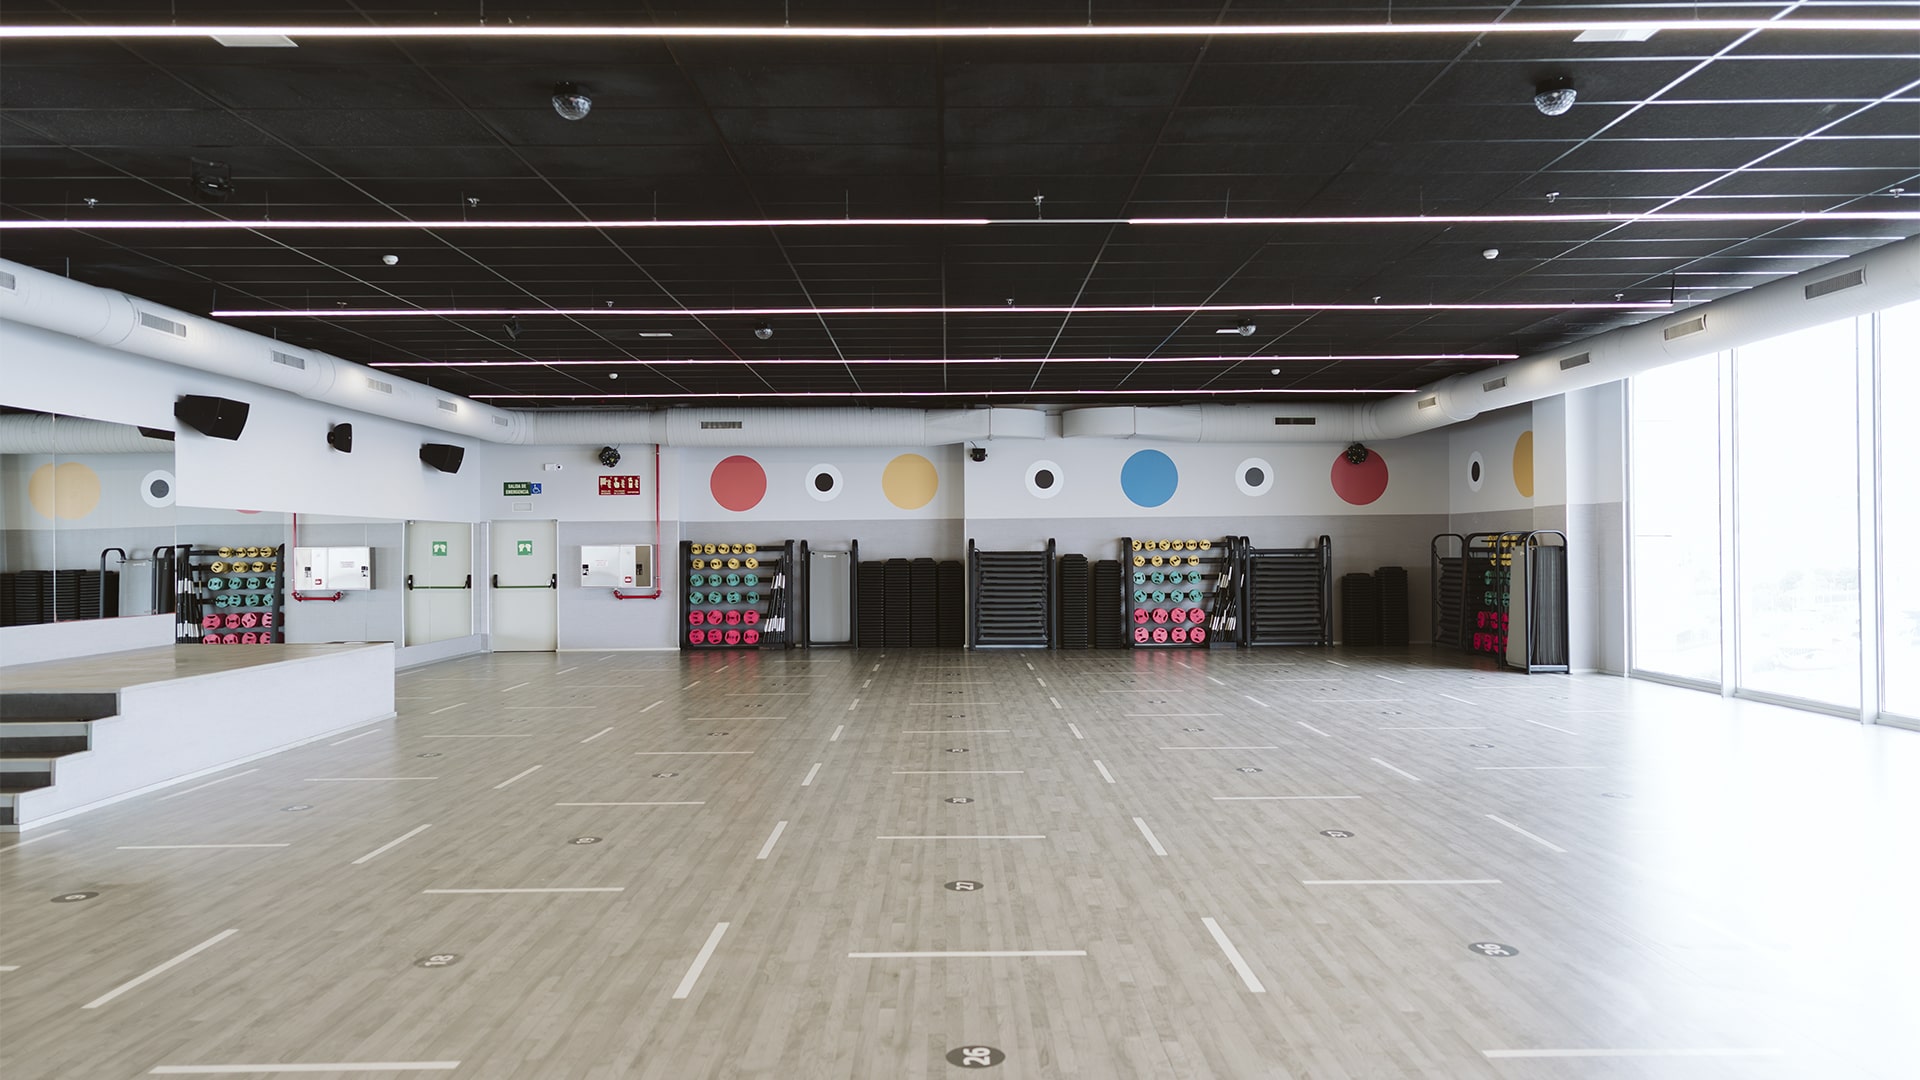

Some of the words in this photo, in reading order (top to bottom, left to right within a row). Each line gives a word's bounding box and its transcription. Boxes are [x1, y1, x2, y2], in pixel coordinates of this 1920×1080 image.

[956, 881, 974, 890] 27
[1476, 943, 1510, 956] 36
[425, 955, 454, 967] 18
[962, 1047, 991, 1066] 26
